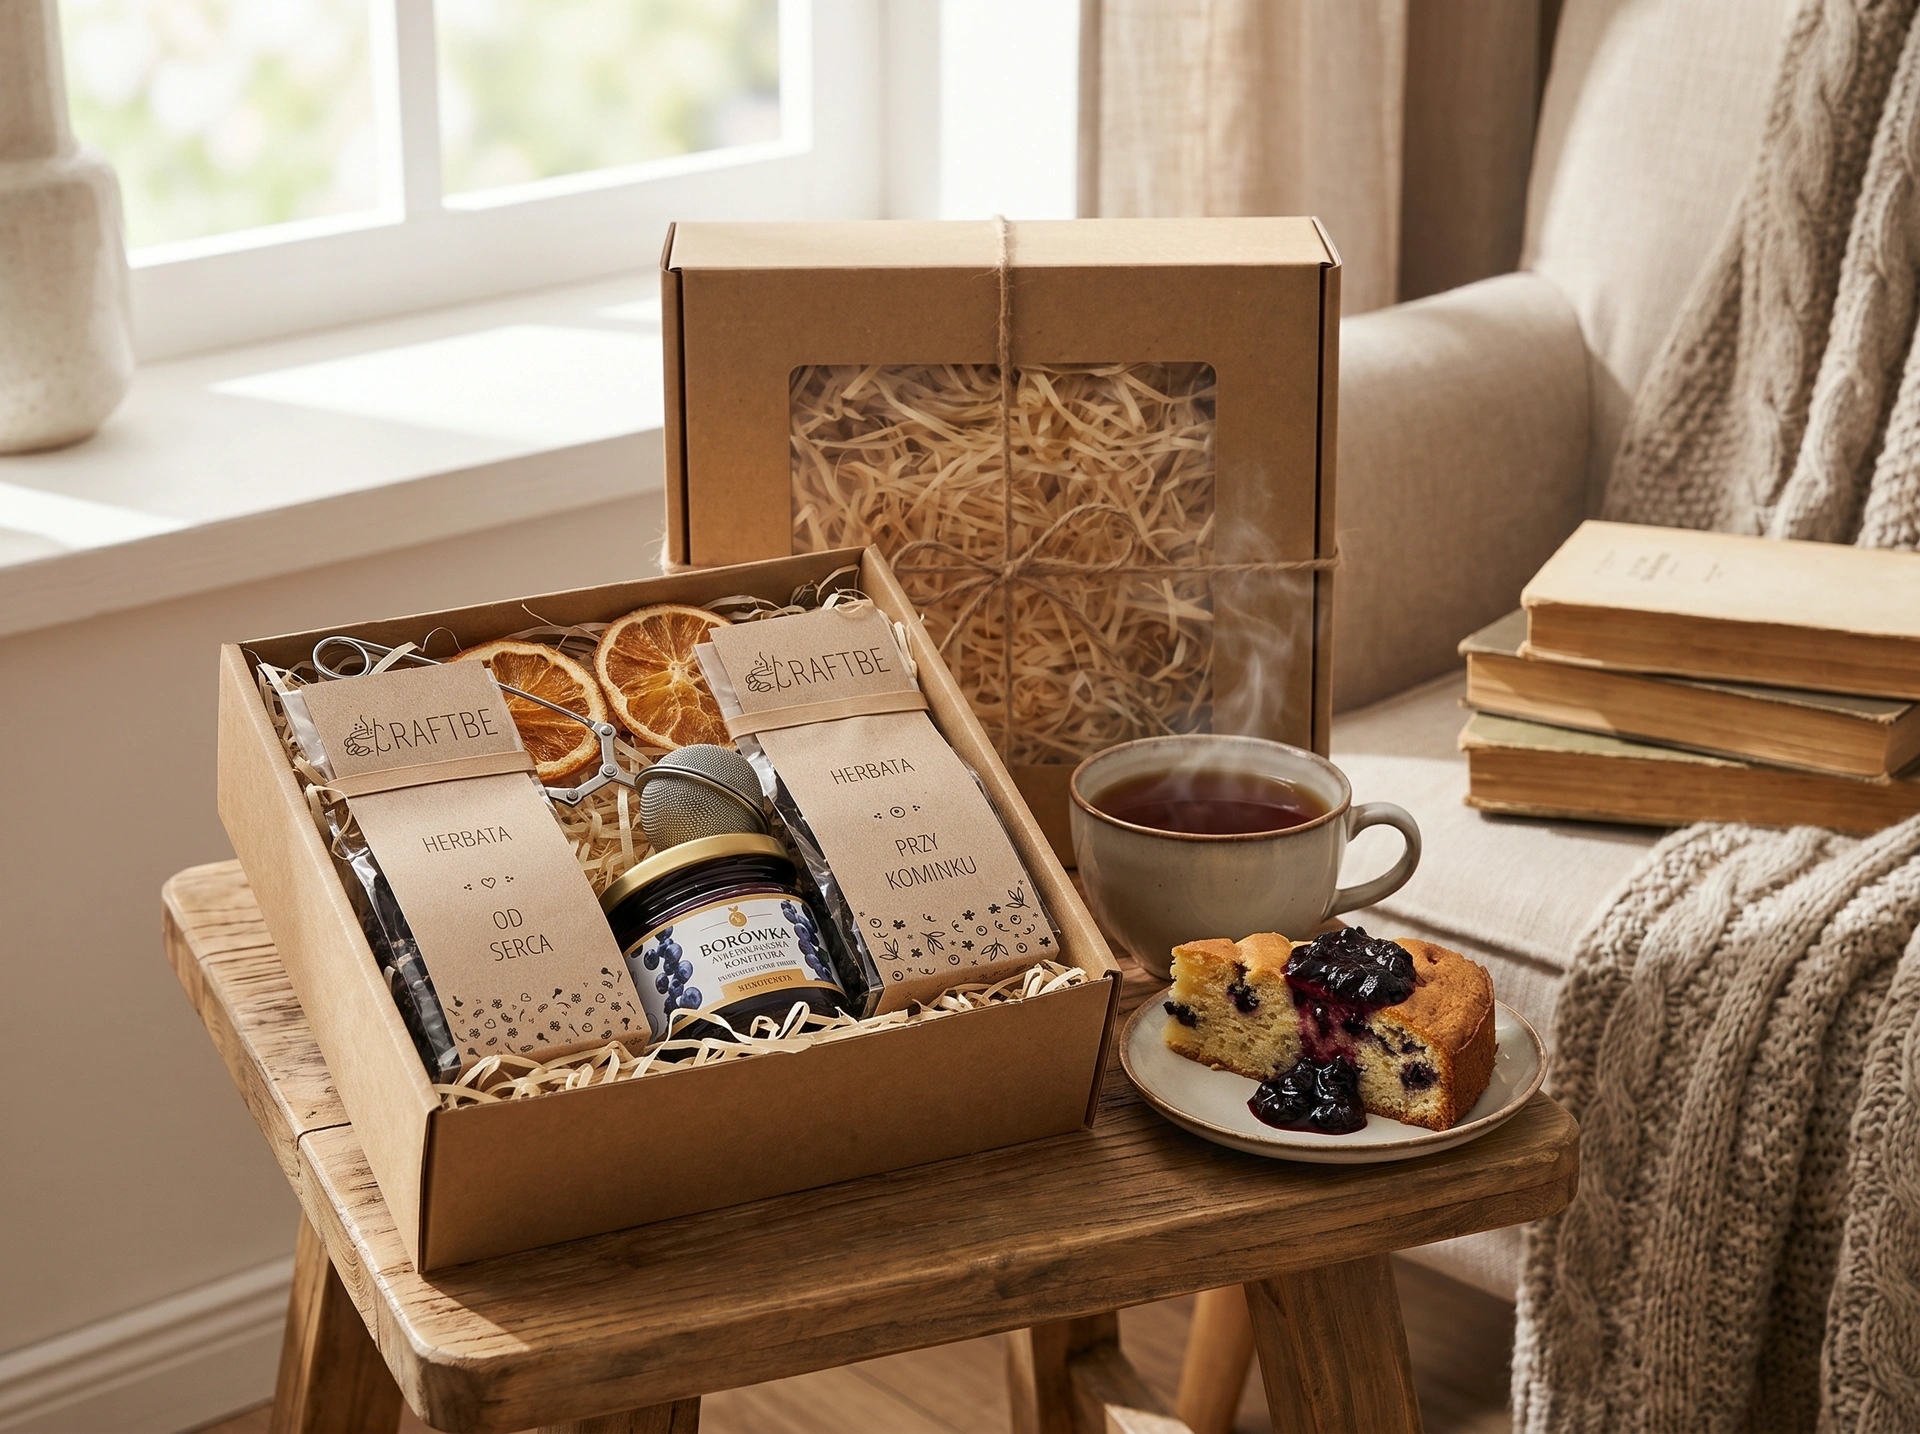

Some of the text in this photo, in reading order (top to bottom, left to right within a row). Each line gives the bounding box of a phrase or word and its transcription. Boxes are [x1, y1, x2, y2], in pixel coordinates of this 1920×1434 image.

[775, 647, 891, 693] CRAFTBE
[374, 709, 498, 757] CRAFTBE
[830, 758, 915, 784] HERBATA
[422, 826, 512, 853] HERBATA
[895, 833, 939, 857] PRZY
[885, 856, 978, 890] KOMINKU
[493, 908, 523, 930] OD
[489, 934, 554, 961] SERCA
[700, 928, 791, 957] BORÓWKA
[724, 950, 785, 969] KONFITURA
